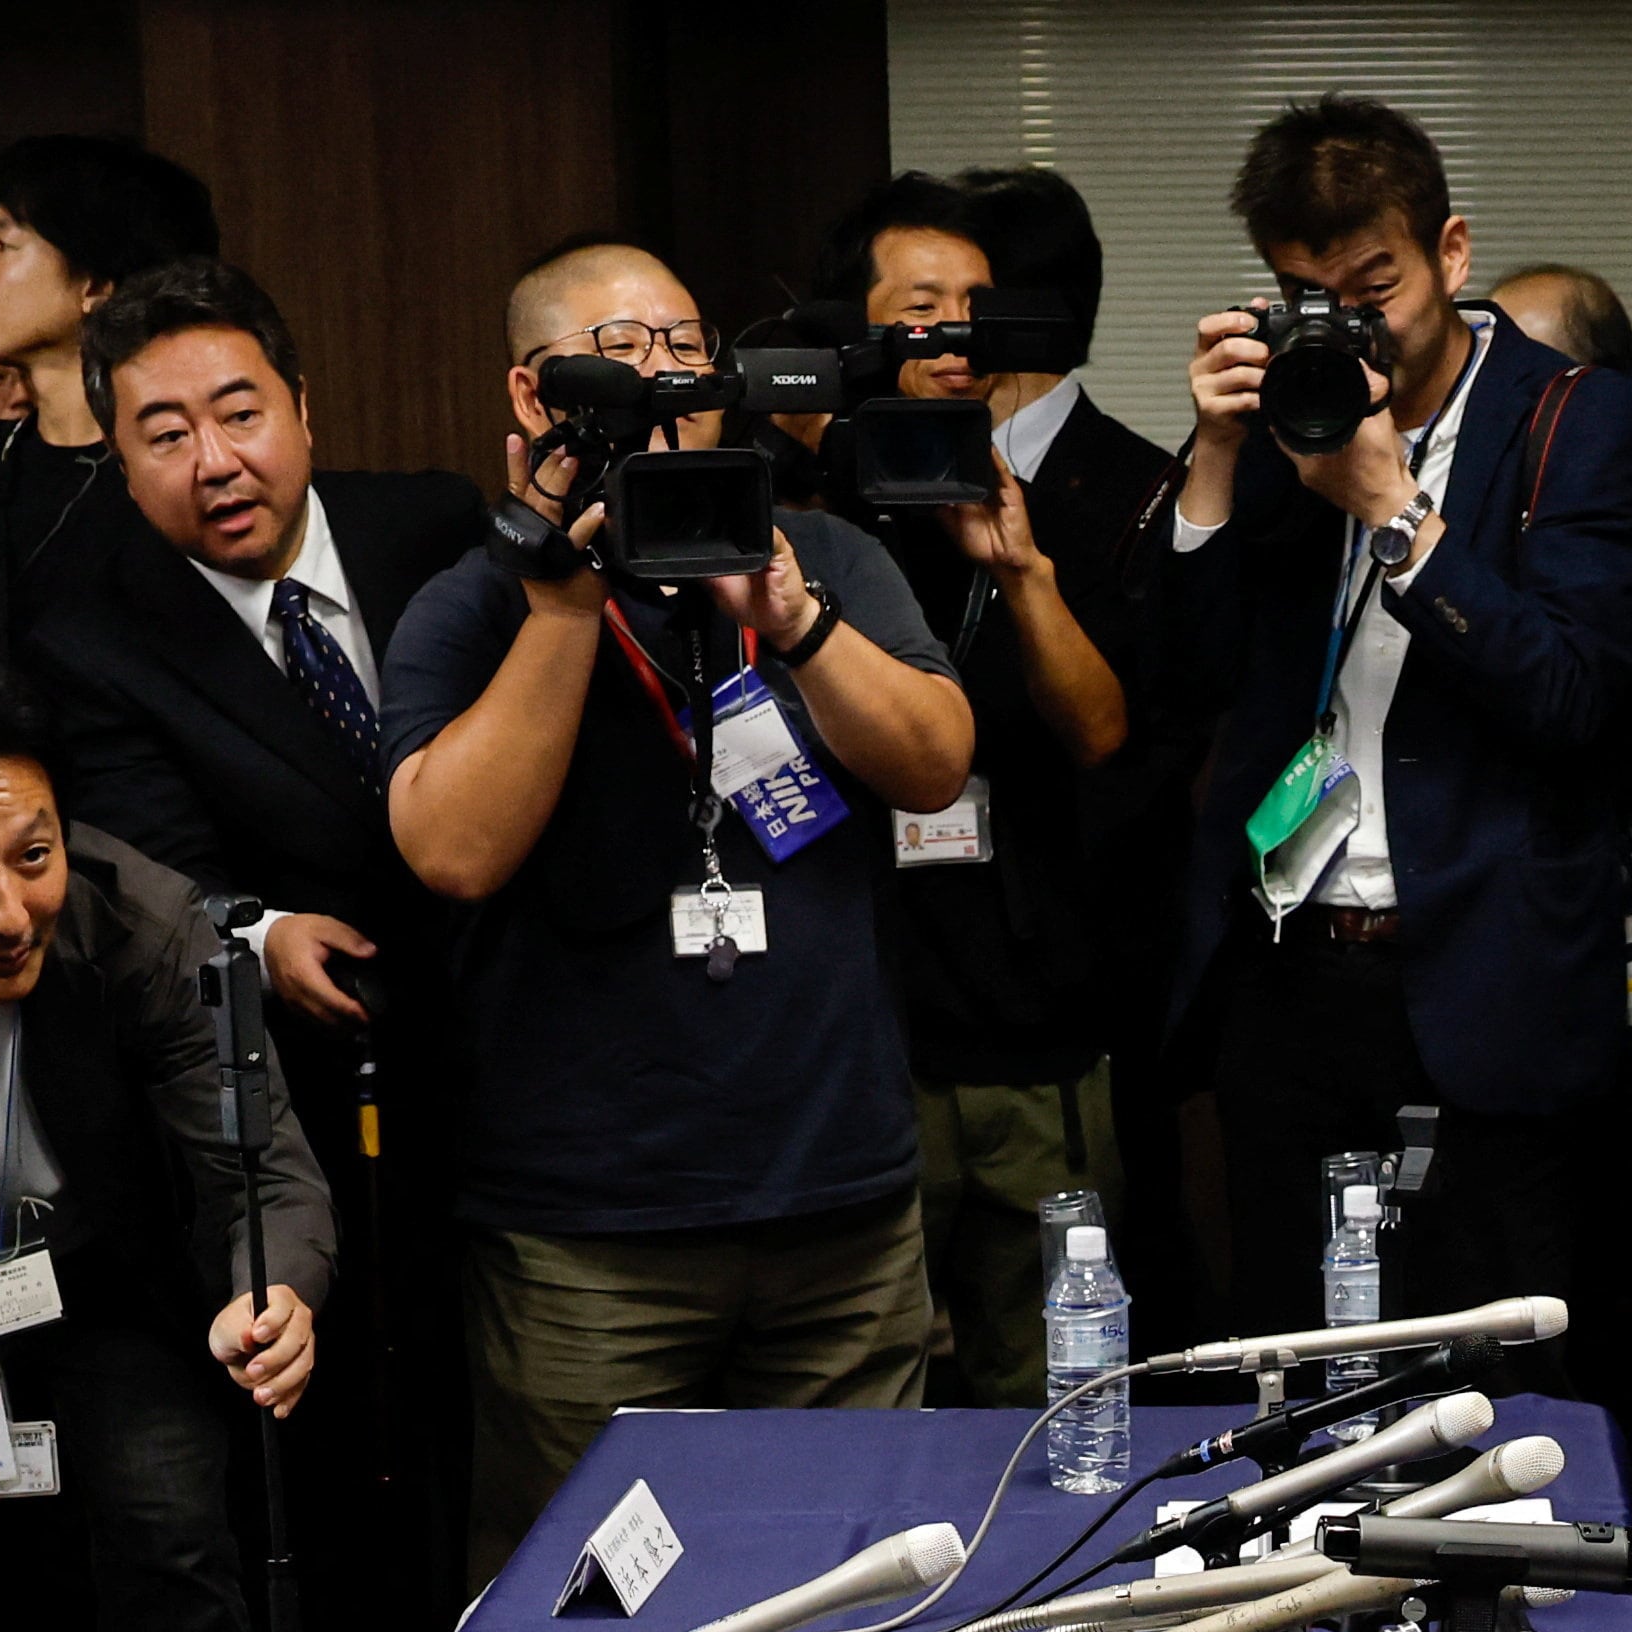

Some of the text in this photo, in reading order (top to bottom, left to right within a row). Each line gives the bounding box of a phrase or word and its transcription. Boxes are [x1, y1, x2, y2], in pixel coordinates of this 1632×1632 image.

[772, 375, 816, 385] XDCAM
[494, 515, 526, 546] SONY
[690, 629, 705, 684] SONY
